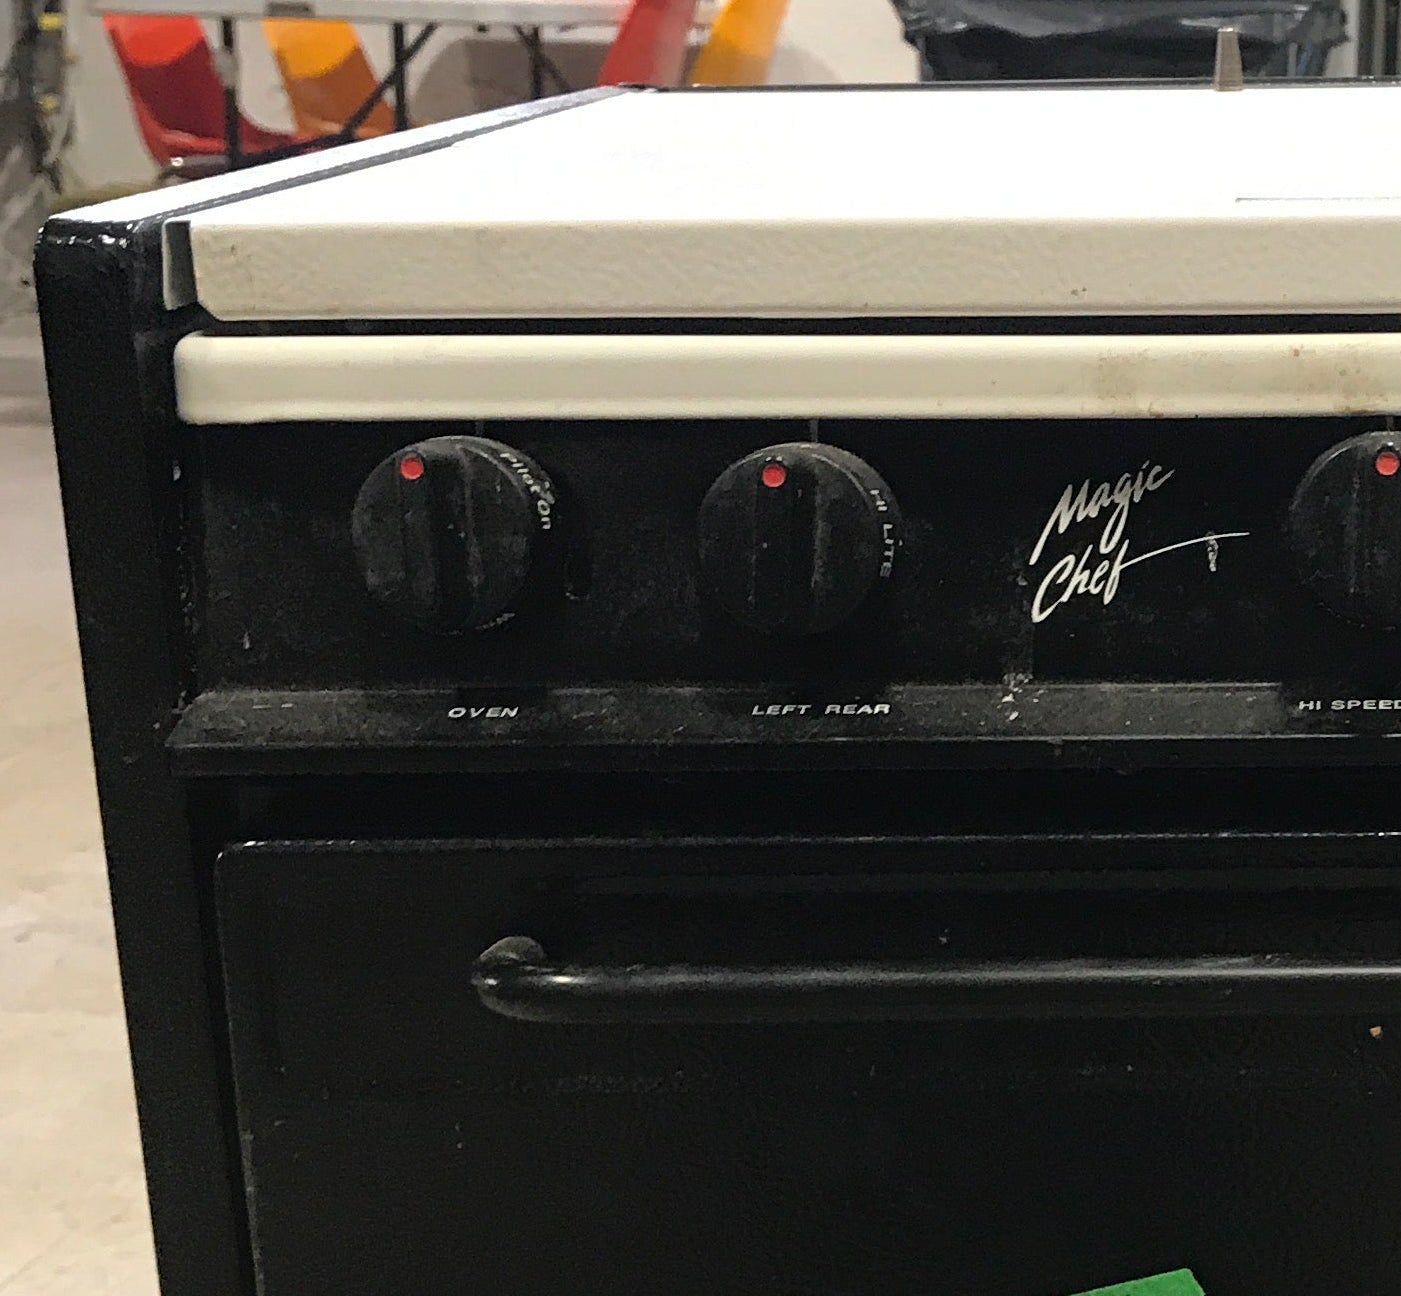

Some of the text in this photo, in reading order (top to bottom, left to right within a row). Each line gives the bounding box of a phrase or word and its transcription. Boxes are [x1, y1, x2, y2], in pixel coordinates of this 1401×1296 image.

[500, 453, 551, 530] Pilot On
[1029, 460, 1176, 566] Magic
[448, 706, 519, 719] OVEN
[751, 703, 891, 717] LEFT REAR
[1299, 700, 1322, 711] HI
